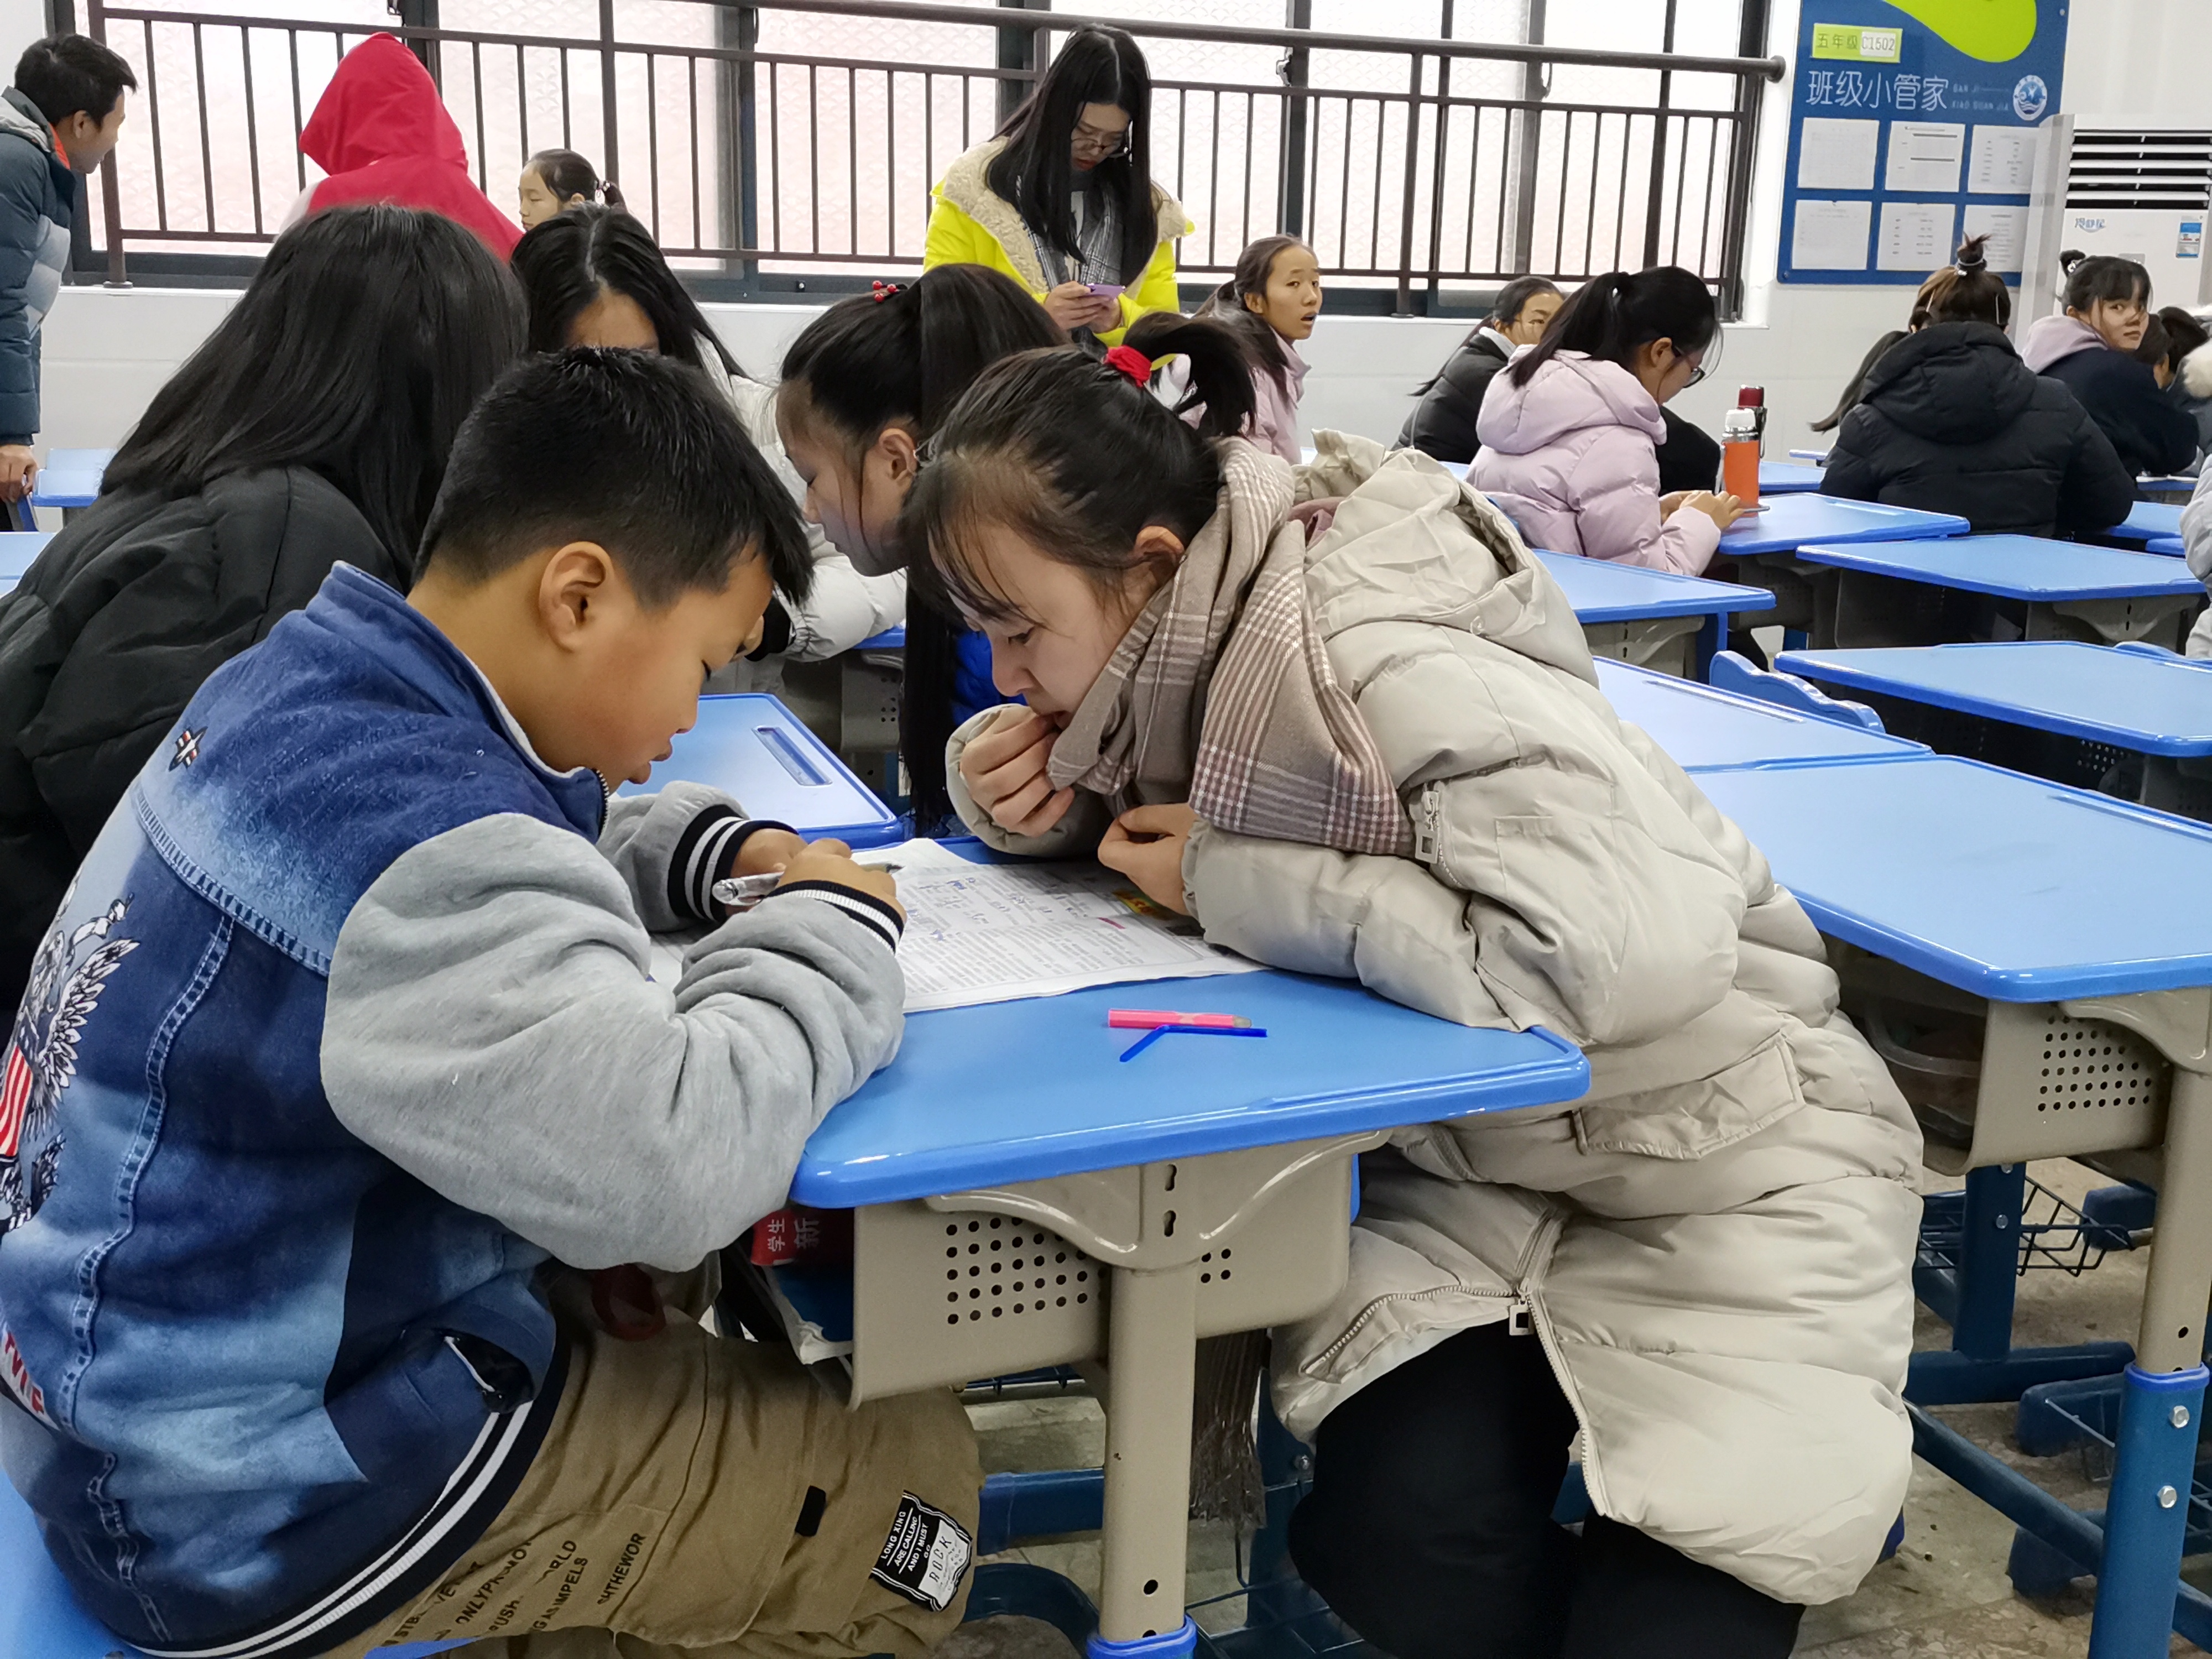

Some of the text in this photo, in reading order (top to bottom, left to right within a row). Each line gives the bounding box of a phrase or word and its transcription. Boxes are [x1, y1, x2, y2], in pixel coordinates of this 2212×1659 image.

[1817, 33, 1858, 50] 五年级
[1806, 70, 1949, 111] 班级小管家
[767, 1218, 786, 1253] 学生
[880, 1511, 906, 1559] LONG XING
[894, 1548, 907, 1566] ARE
[907, 1552, 920, 1572] AND
